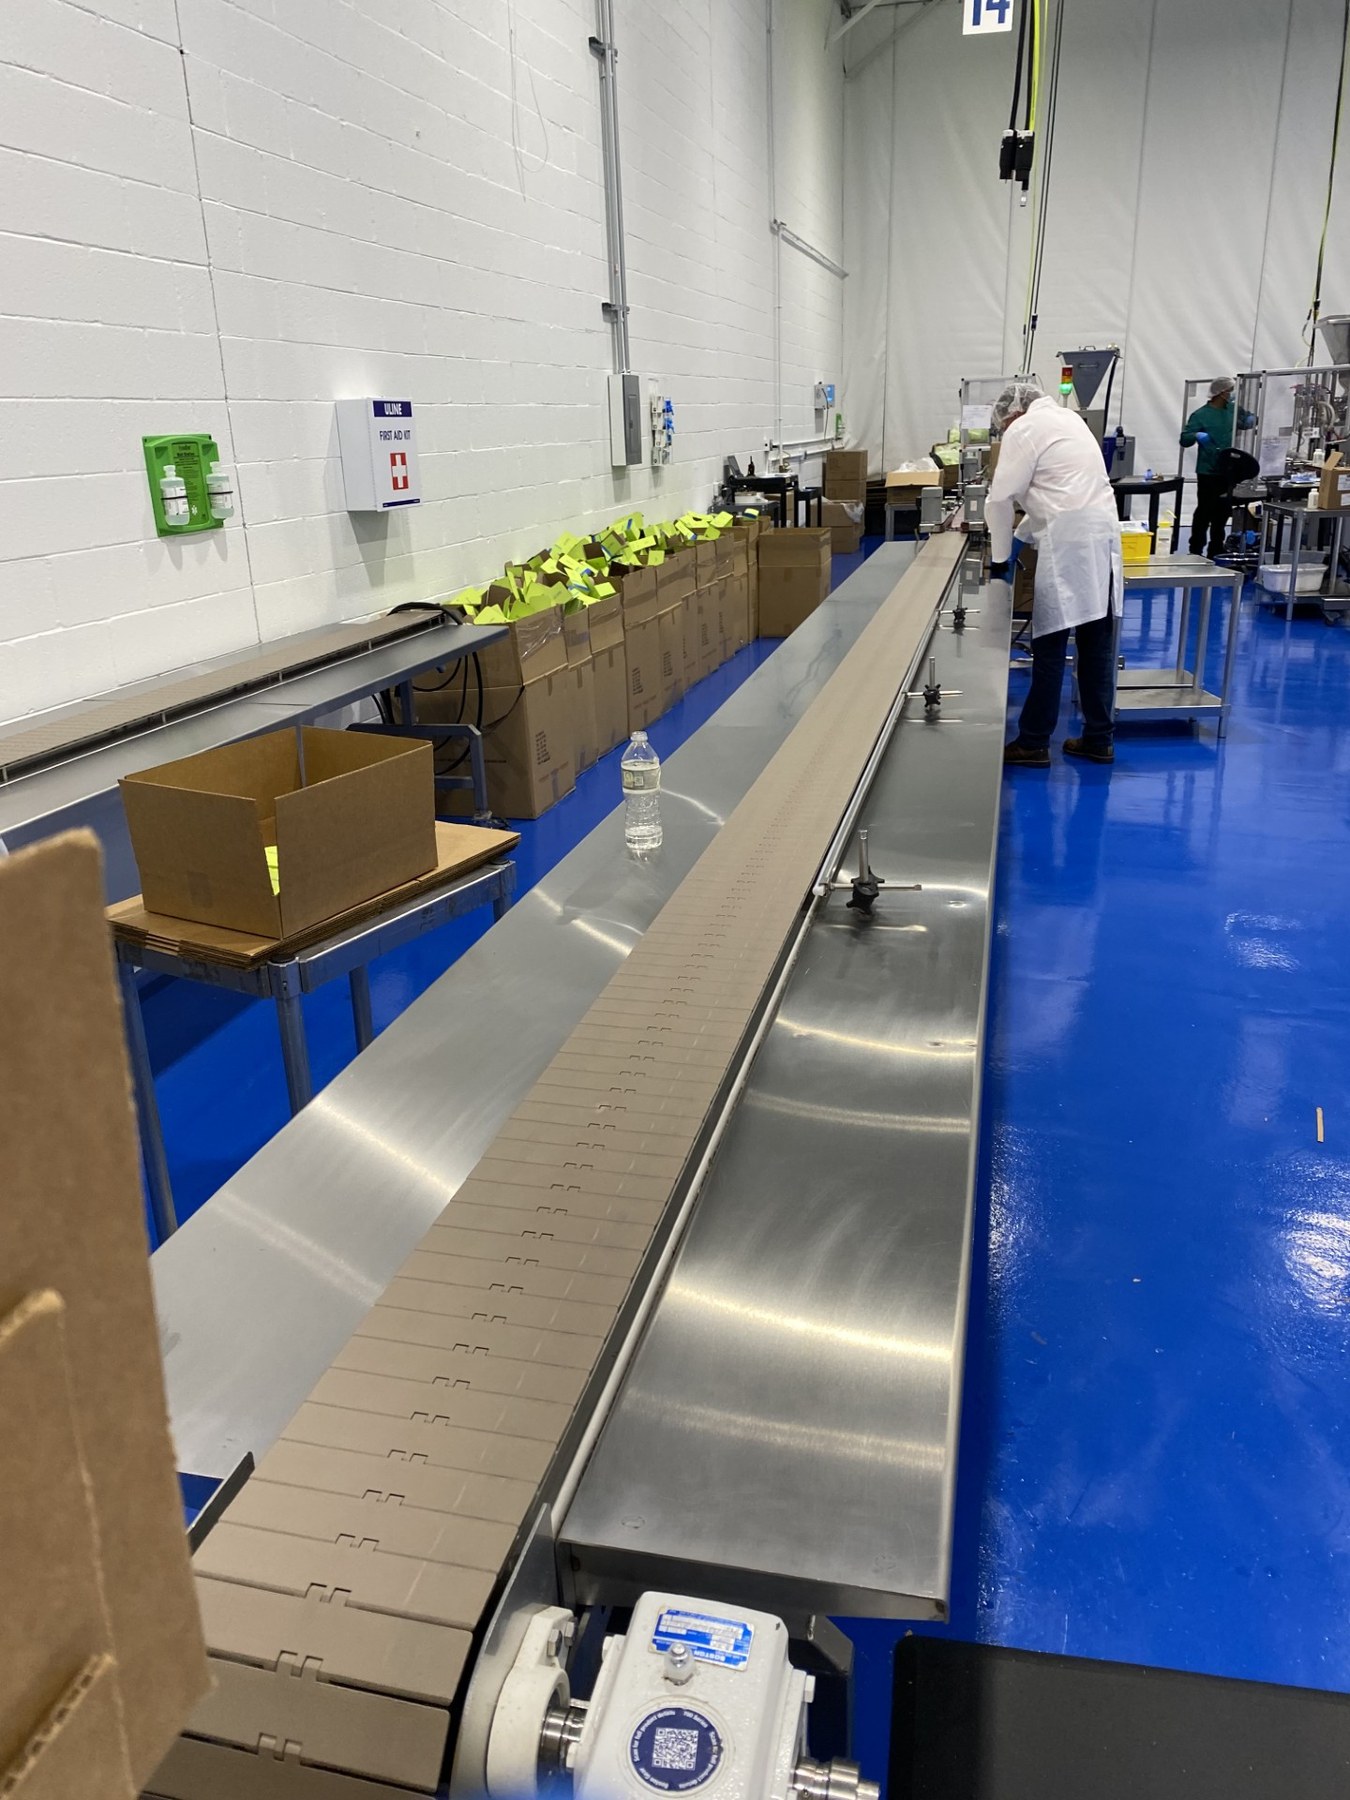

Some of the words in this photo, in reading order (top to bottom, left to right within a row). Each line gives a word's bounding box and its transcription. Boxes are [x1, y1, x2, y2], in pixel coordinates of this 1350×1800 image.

[383, 402, 402, 415] ULINE
[379, 430, 392, 441] FIRST
[393, 430, 402, 441] AID
[694, 1649, 726, 1662] BOSTON
